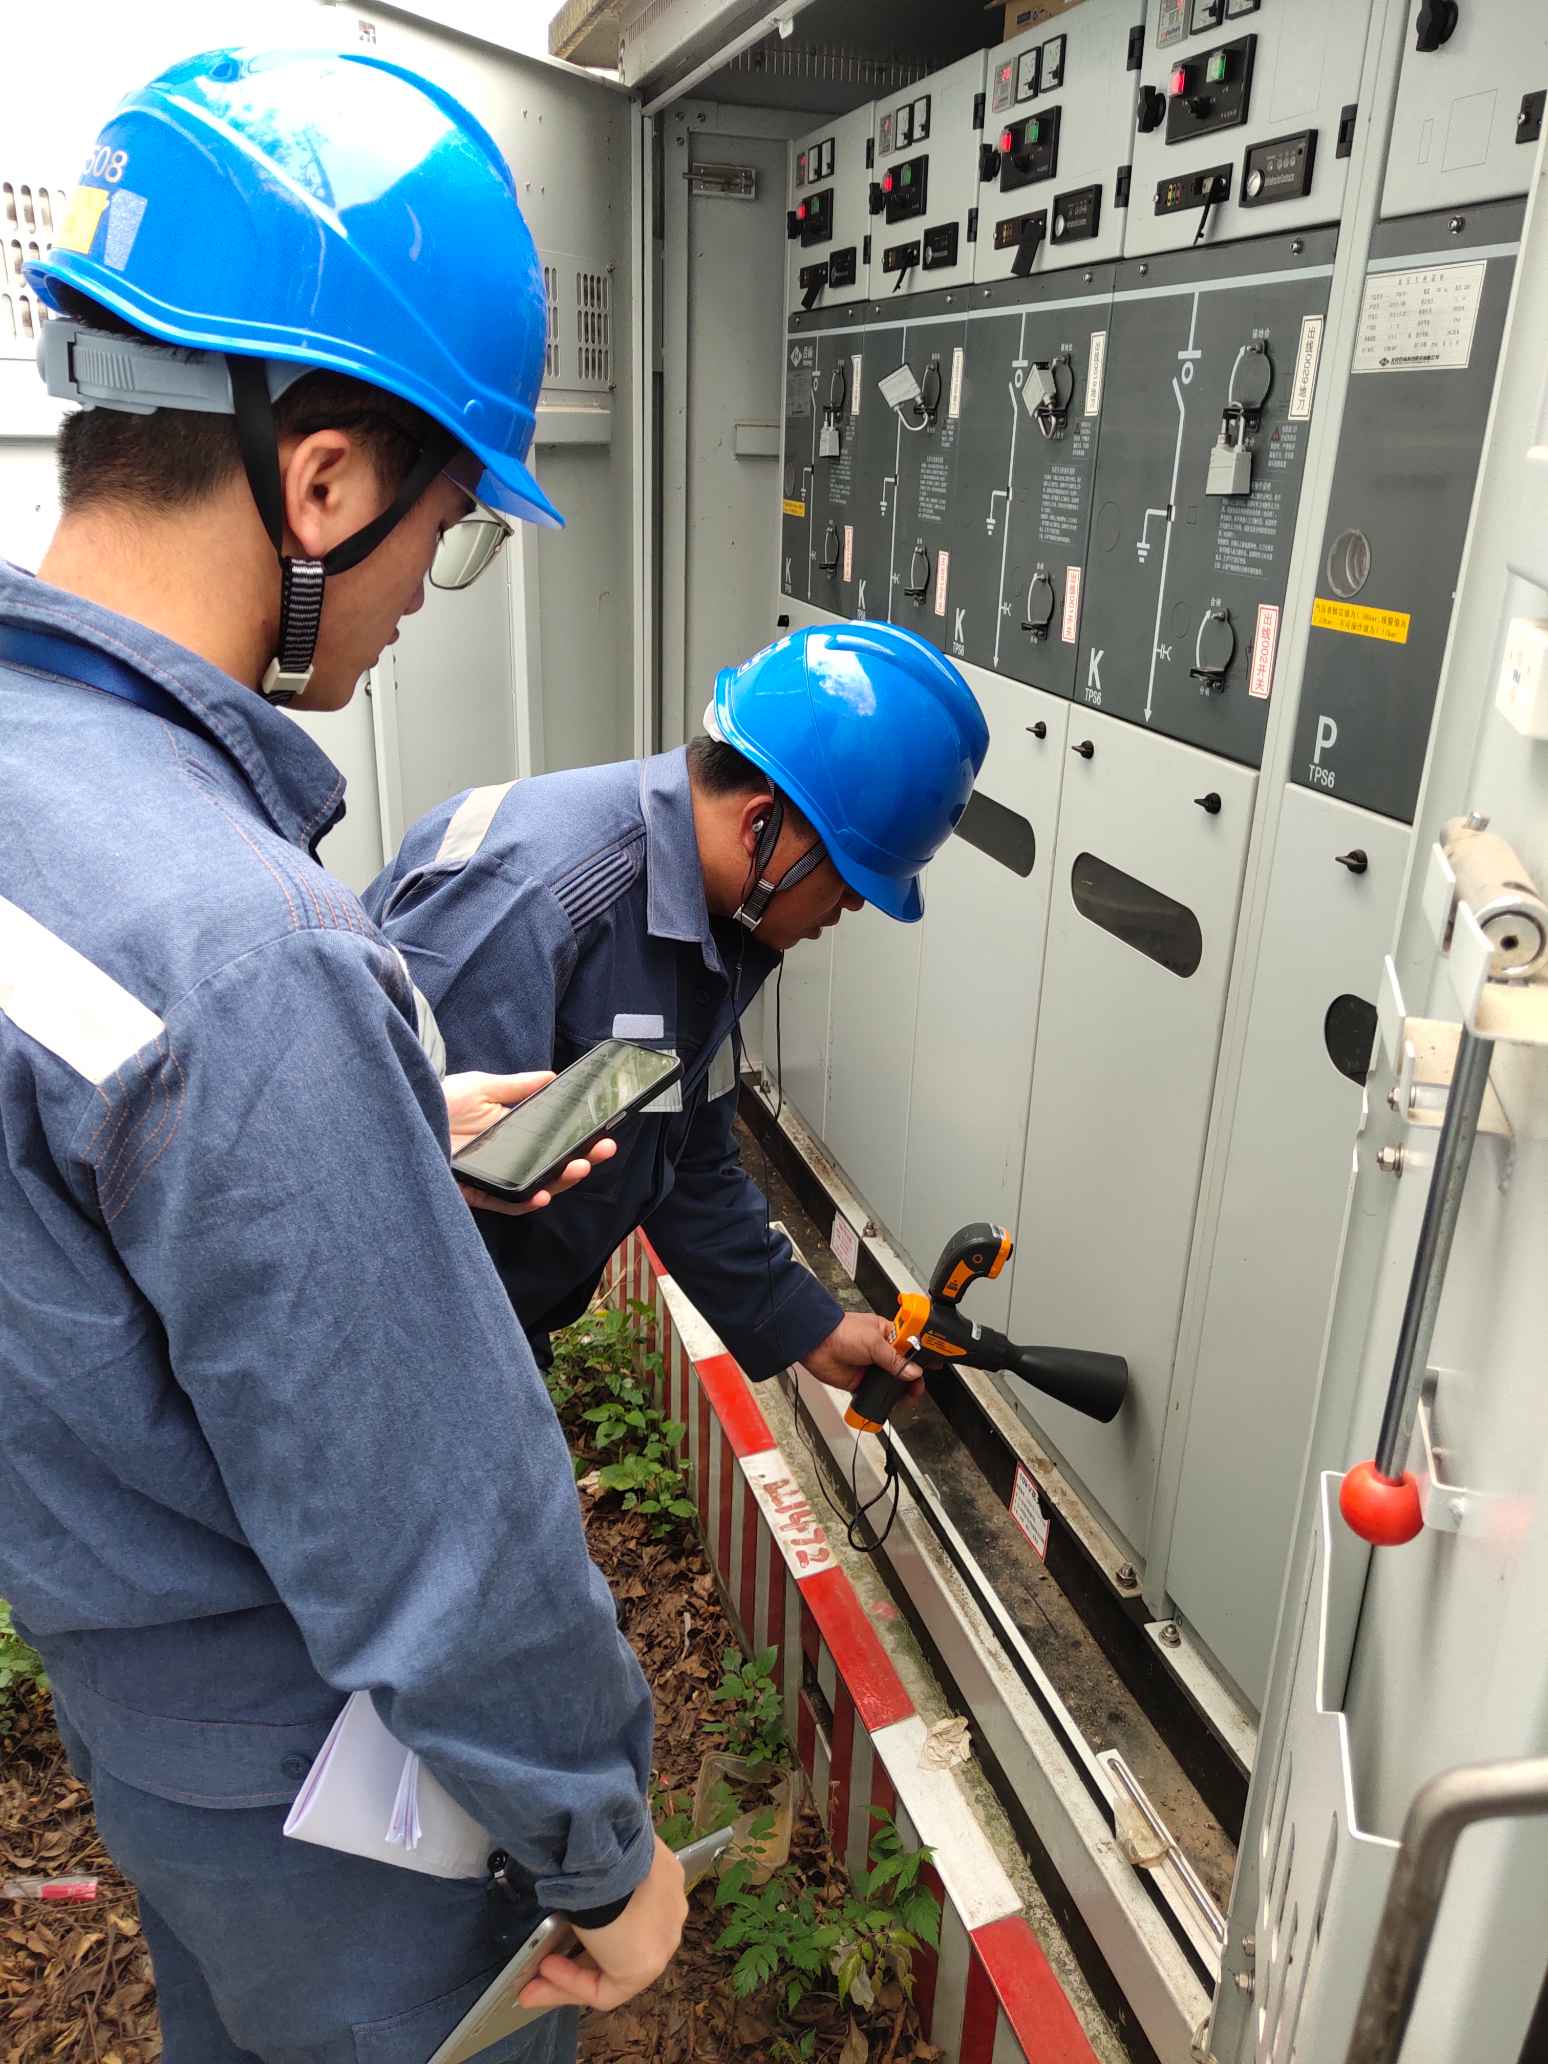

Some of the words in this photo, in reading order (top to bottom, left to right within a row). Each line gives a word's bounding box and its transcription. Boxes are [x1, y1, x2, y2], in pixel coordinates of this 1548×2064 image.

[858, 578, 867, 610] K
[954, 607, 966, 643] K
[1087, 647, 1105, 690] K
[1085, 687, 1102, 706] TPS6
[1313, 714, 1338, 764] P
[1308, 763, 1336, 788] TPS6
